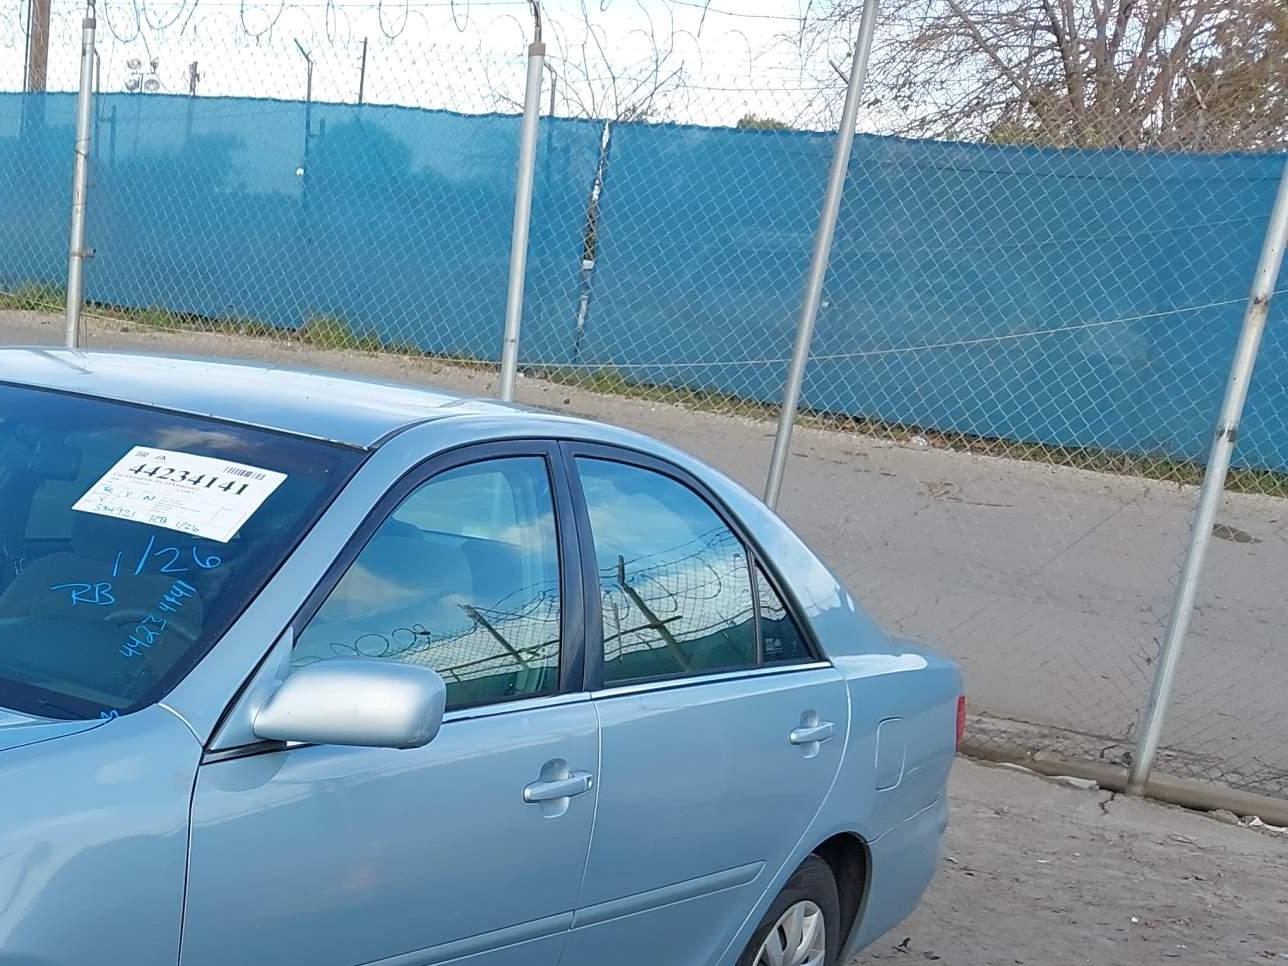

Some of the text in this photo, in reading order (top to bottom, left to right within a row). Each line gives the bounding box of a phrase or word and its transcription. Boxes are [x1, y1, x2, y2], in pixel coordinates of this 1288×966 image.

[128, 463, 249, 496] 44234141
[112, 535, 222, 578] 1/26
[50, 582, 116, 606] RB
